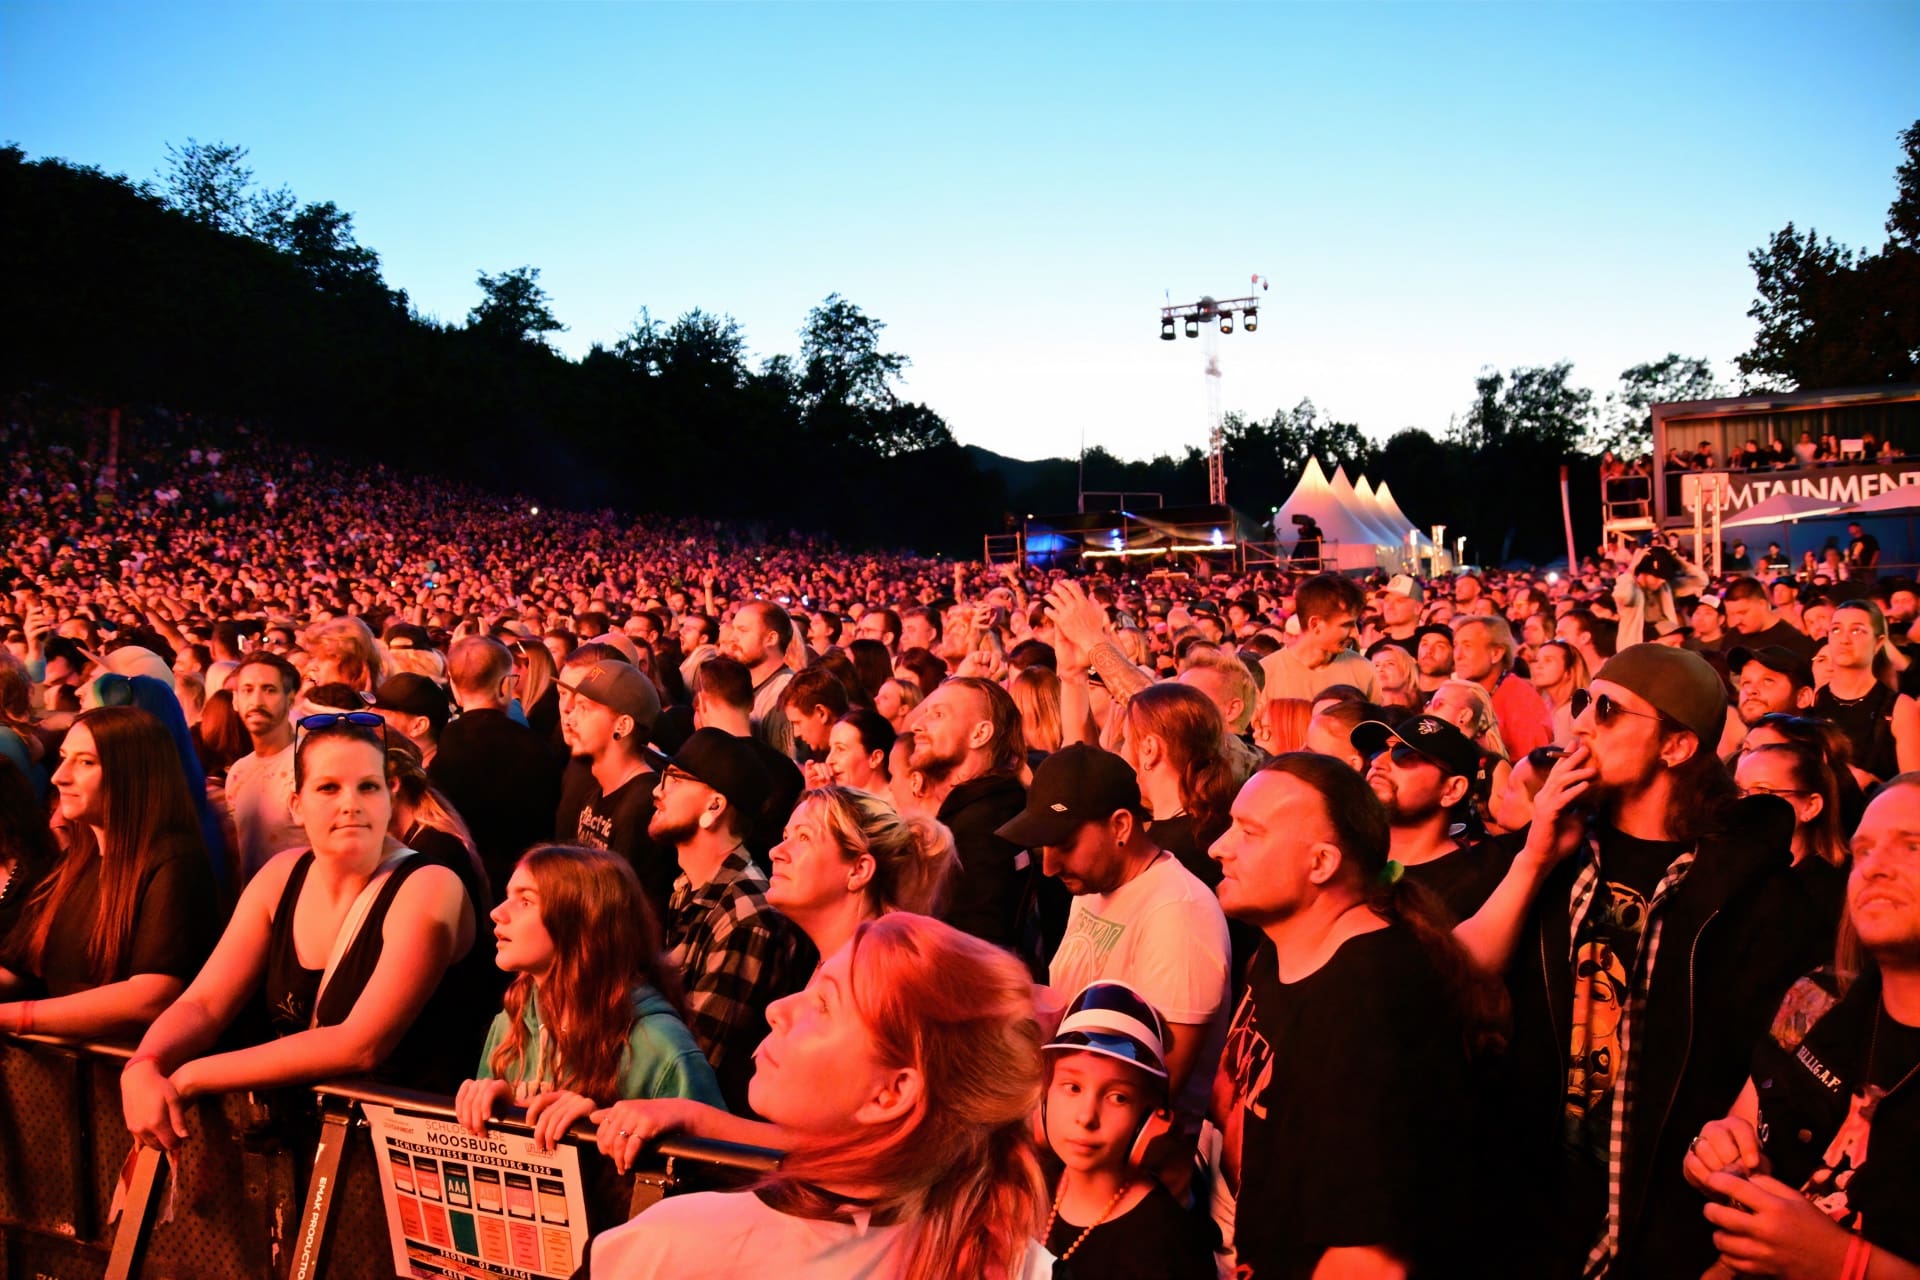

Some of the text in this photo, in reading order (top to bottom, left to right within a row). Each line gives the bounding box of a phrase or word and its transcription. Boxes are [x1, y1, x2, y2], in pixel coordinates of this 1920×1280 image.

[1686, 472, 1920, 512] MTAINMEN
[395, 1140, 463, 1160] SCHLOSSWIESE
[467, 1153, 524, 1170] MOOSBURG
[427, 1131, 508, 1155] MOOSBURG
[448, 1179, 467, 1195] AAA
[297, 1176, 328, 1280] EMAK PRODUCTIO
[440, 1249, 532, 1280] FRONT OF STAGE
